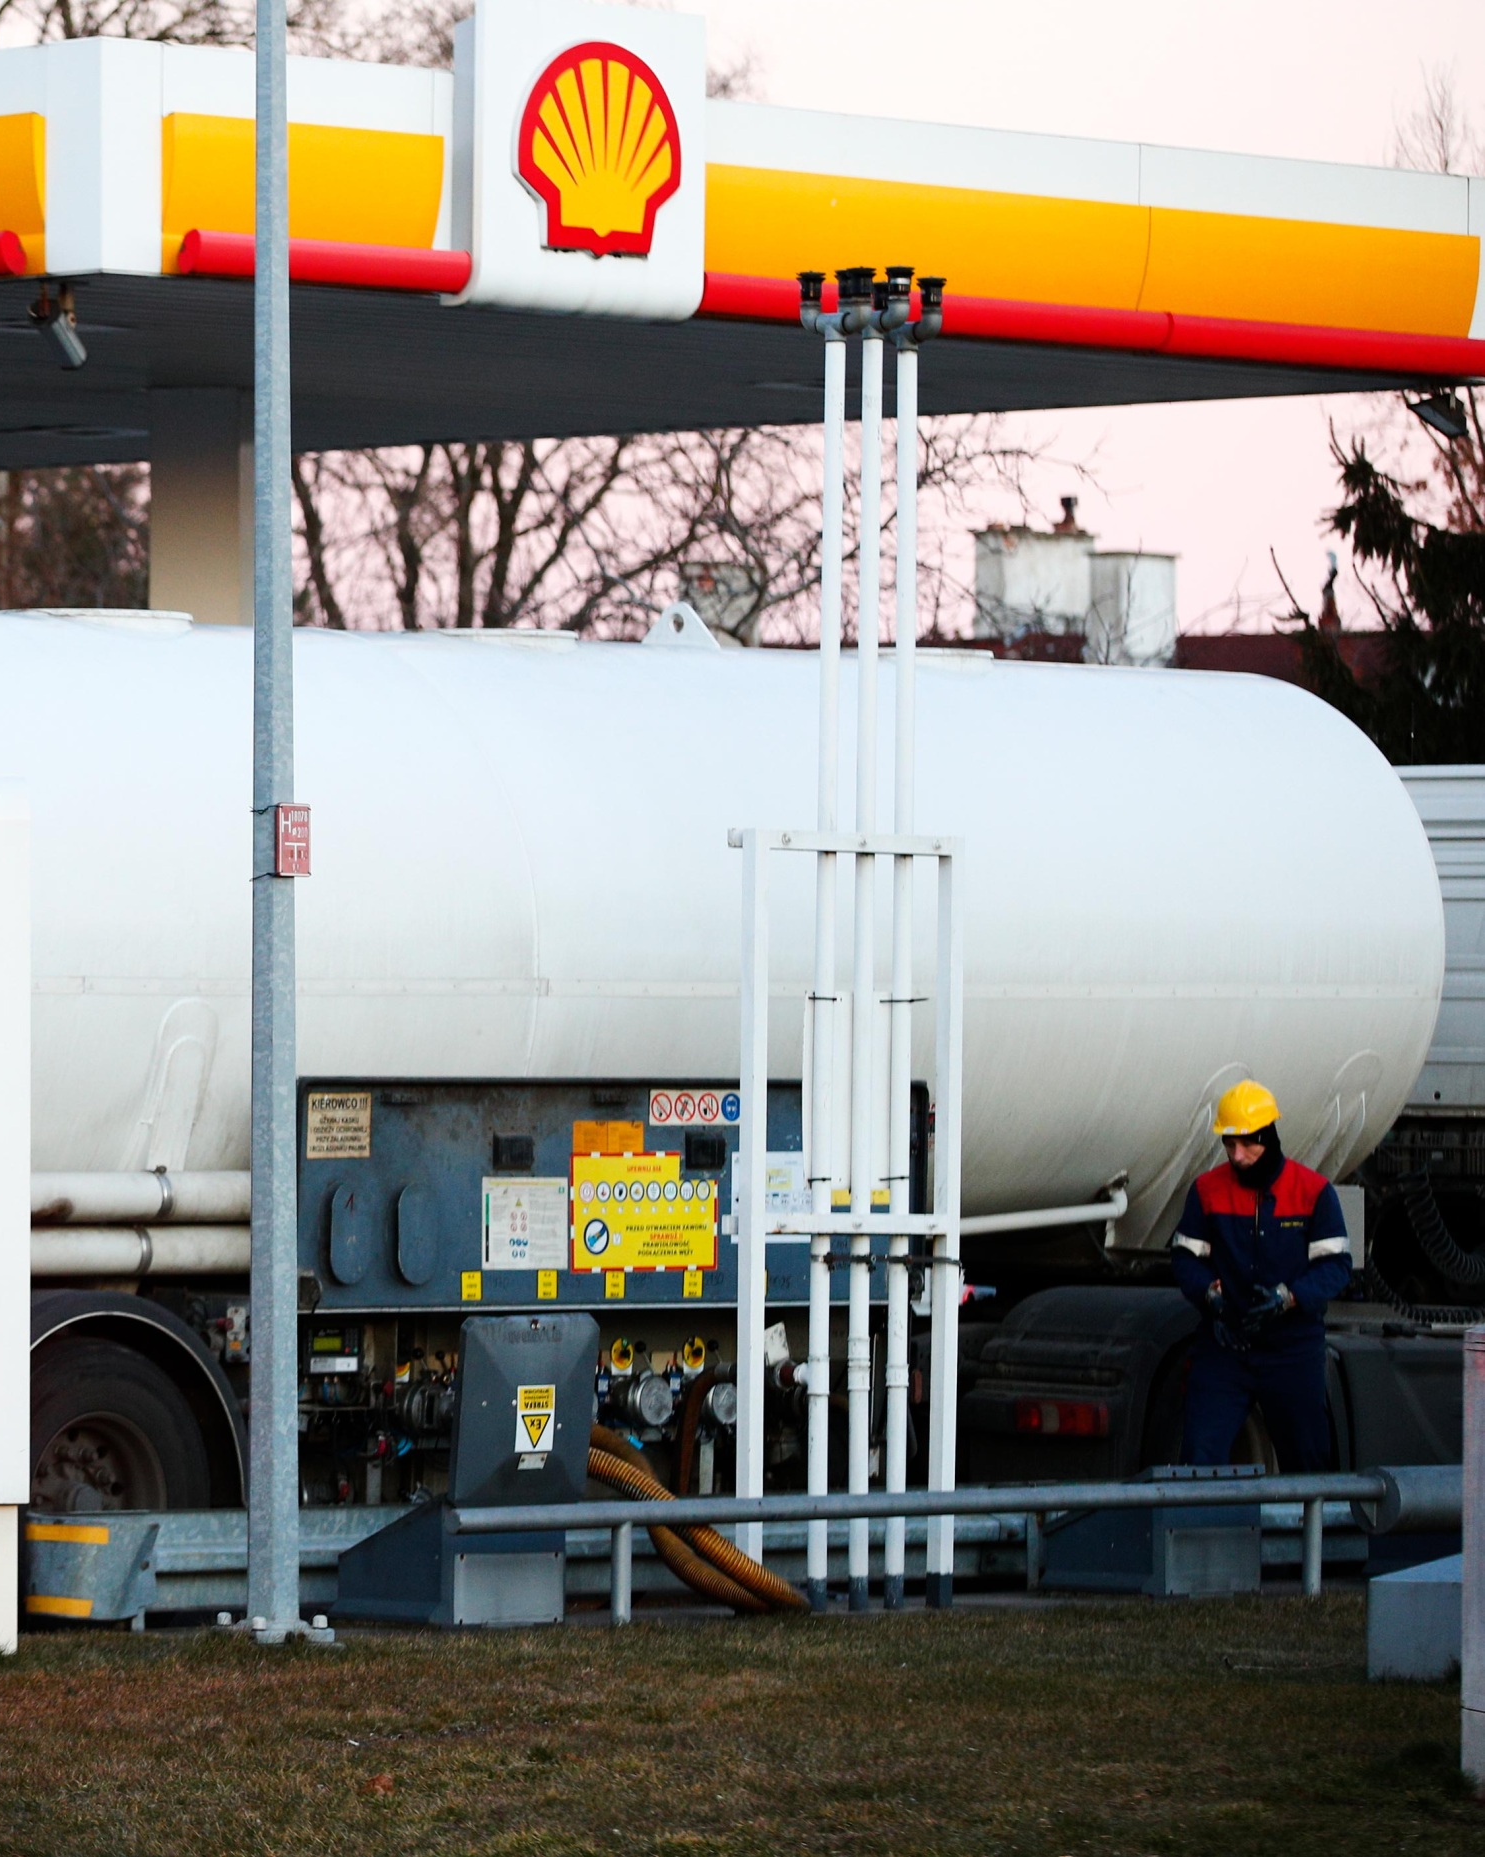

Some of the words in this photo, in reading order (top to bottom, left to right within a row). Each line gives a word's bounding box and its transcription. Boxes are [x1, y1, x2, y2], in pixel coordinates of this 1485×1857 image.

[281, 812, 292, 833] H
[312, 1098, 357, 1110] KIEROWCO
[530, 1418, 541, 1430] Ex
